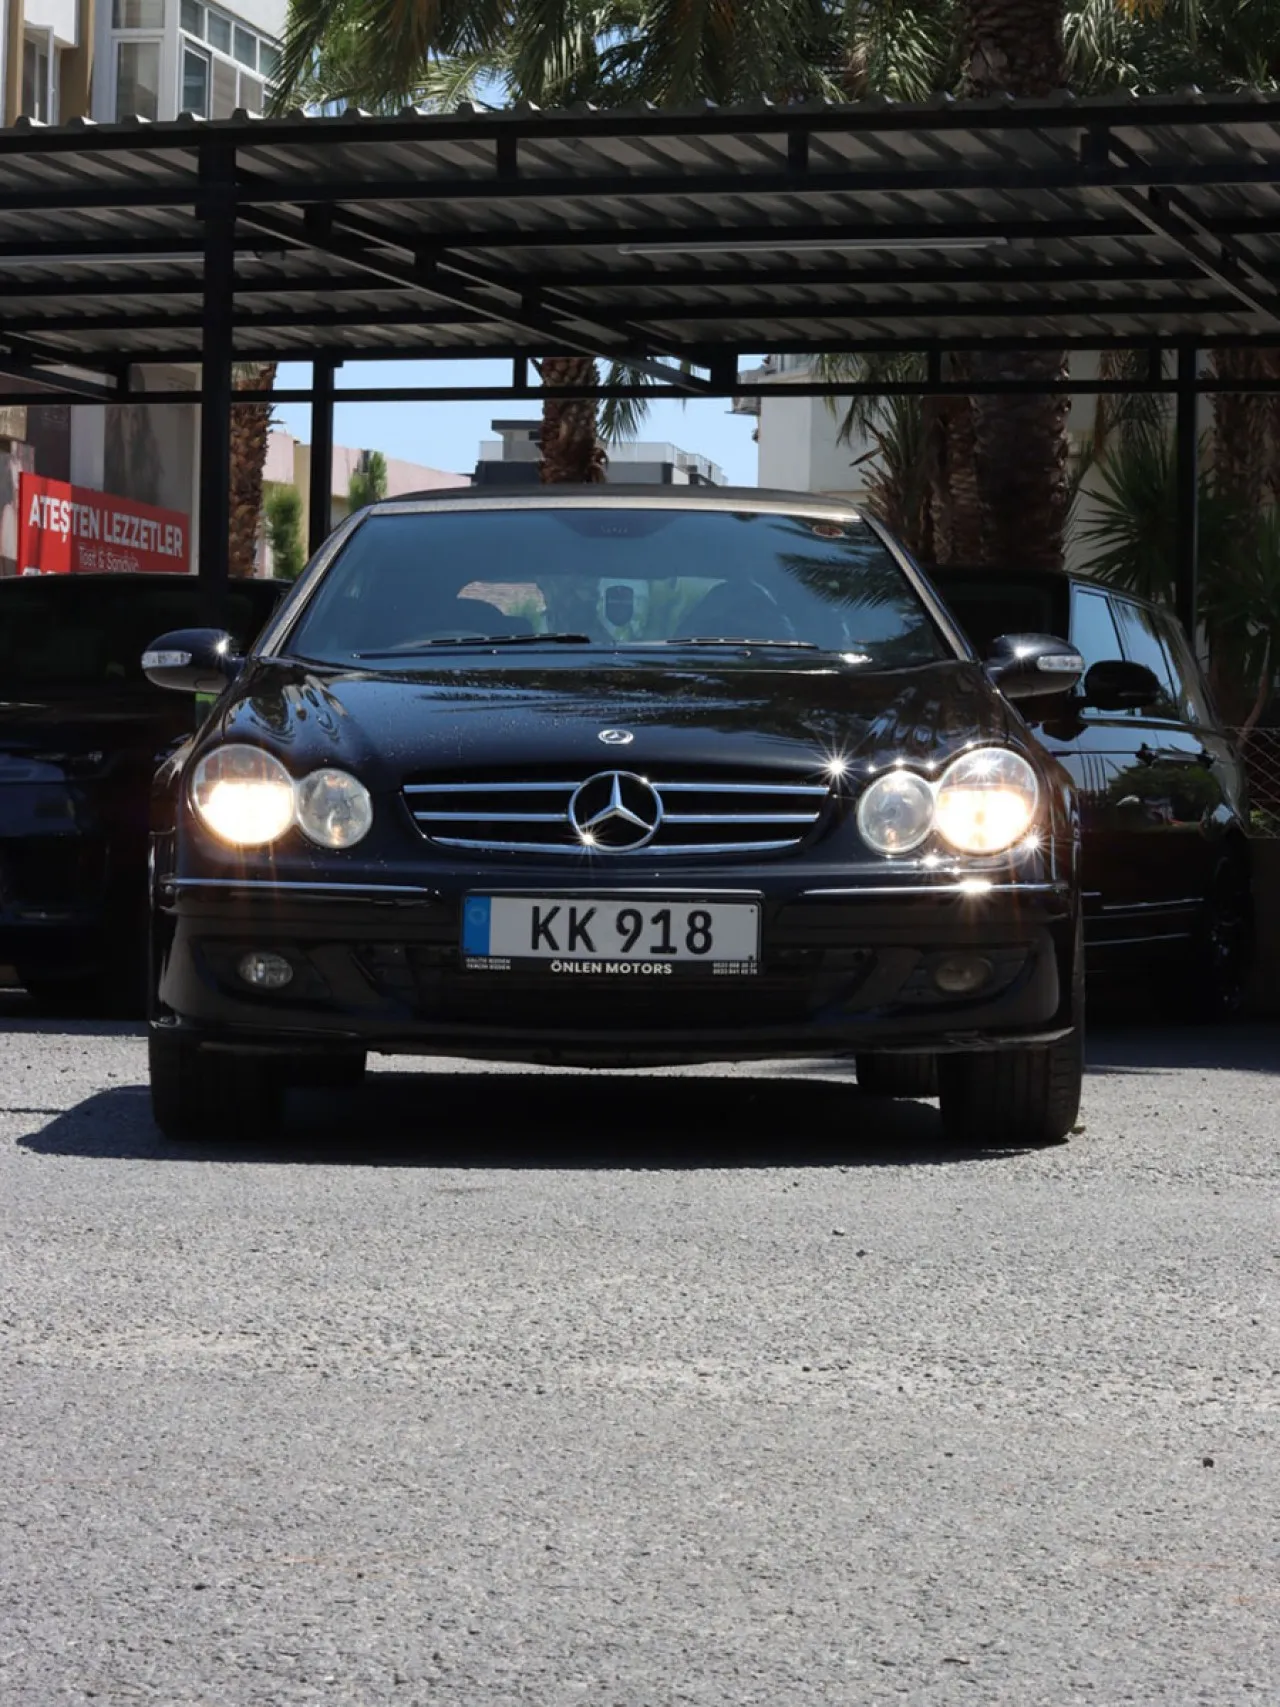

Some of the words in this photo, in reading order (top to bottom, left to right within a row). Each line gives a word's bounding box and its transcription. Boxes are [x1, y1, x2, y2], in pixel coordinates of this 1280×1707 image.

[29, 494, 100, 543] ATEŞTEN
[103, 509, 183, 558] LEZZETLER
[79, 546, 96, 567] Tost
[531, 905, 598, 953] KK
[616, 908, 713, 955] 918
[551, 959, 602, 974] ÖNLEN
[605, 962, 672, 975] MOTORS
